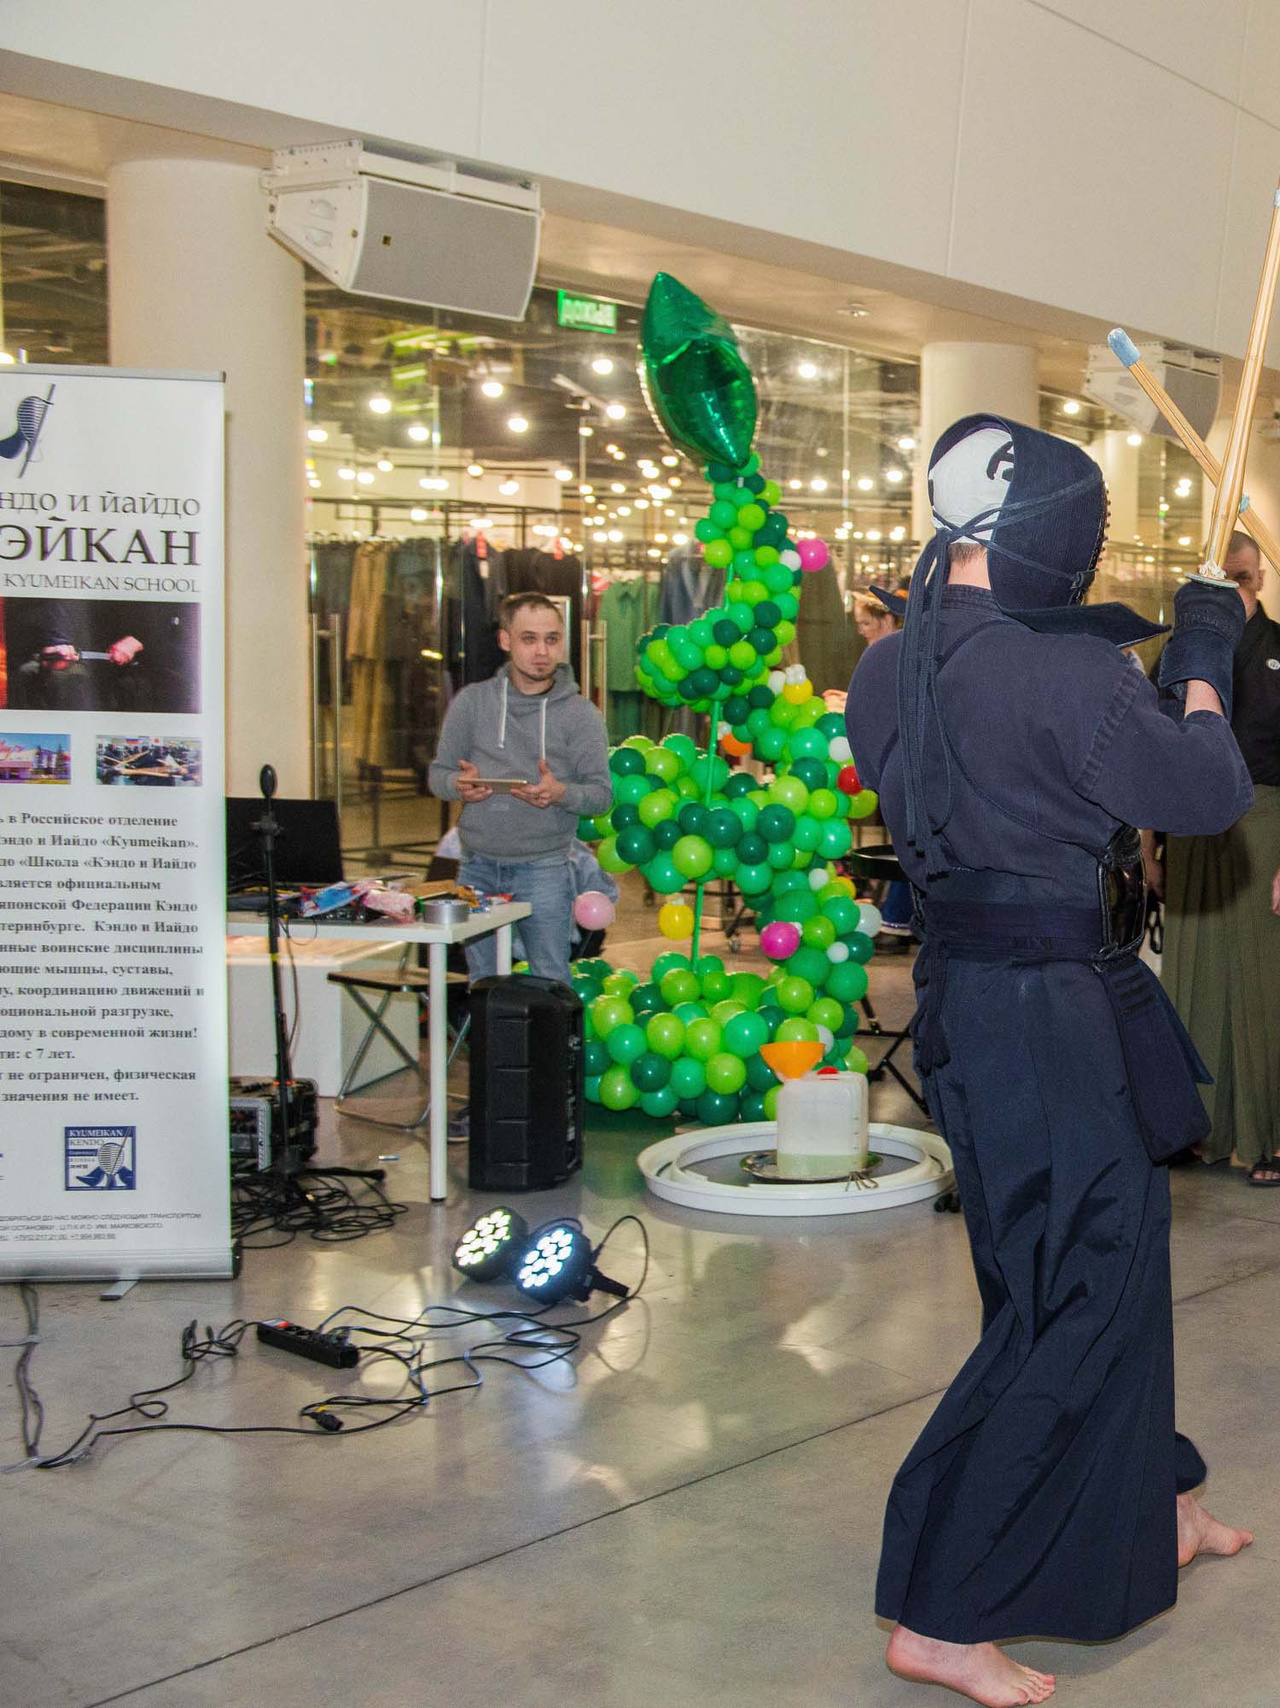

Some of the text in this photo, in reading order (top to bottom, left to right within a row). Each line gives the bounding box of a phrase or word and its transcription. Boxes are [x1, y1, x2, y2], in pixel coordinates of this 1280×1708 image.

[68, 494, 89, 512] и
[99, 490, 201, 519] йайдо
[4, 574, 201, 593] KYUMEIKAN SCHOOL
[9, 815, 17, 824] в
[22, 812, 103, 825] Российское
[109, 816, 178, 827] отделение
[0, 836, 33, 847] эндо
[38, 838, 46, 846] и
[51, 834, 97, 847] Иайдо
[20, 856, 79, 867] «Школа
[84, 857, 135, 869] «Кэндо
[140, 860, 148, 869] и
[152, 857, 197, 870] Иайдо
[57, 878, 161, 891] официальным
[72, 899, 151, 913] Федерации
[155, 900, 197, 912] Кэндо
[95, 921, 137, 932] Кэндо
[142, 924, 150, 932] и
[154, 921, 198, 933] Иайдо
[41, 944, 110, 953] воинские
[114, 944, 204, 955] дисциплины
[45, 965, 108, 976] мышцы,
[112, 966, 173, 977] суставы,
[17, 986, 118, 998] координацию
[121, 986, 191, 997] движений
[196, 988, 205, 996] и
[101, 1008, 174, 1020] разгрузке,
[39, 1030, 47, 1038] в
[51, 1027, 144, 1040] современной
[149, 1027, 198, 1038] жизни!
[36, 1048, 44, 1059] 7
[47, 1050, 75, 1059] лет.
[8, 1072, 26, 1080] не
[29, 1071, 109, 1083] ограничен,
[113, 1069, 196, 1083] физическая
[2, 1092, 139, 1102] значения не имеет.
[69, 1129, 123, 1137] KYUMEIKAN
